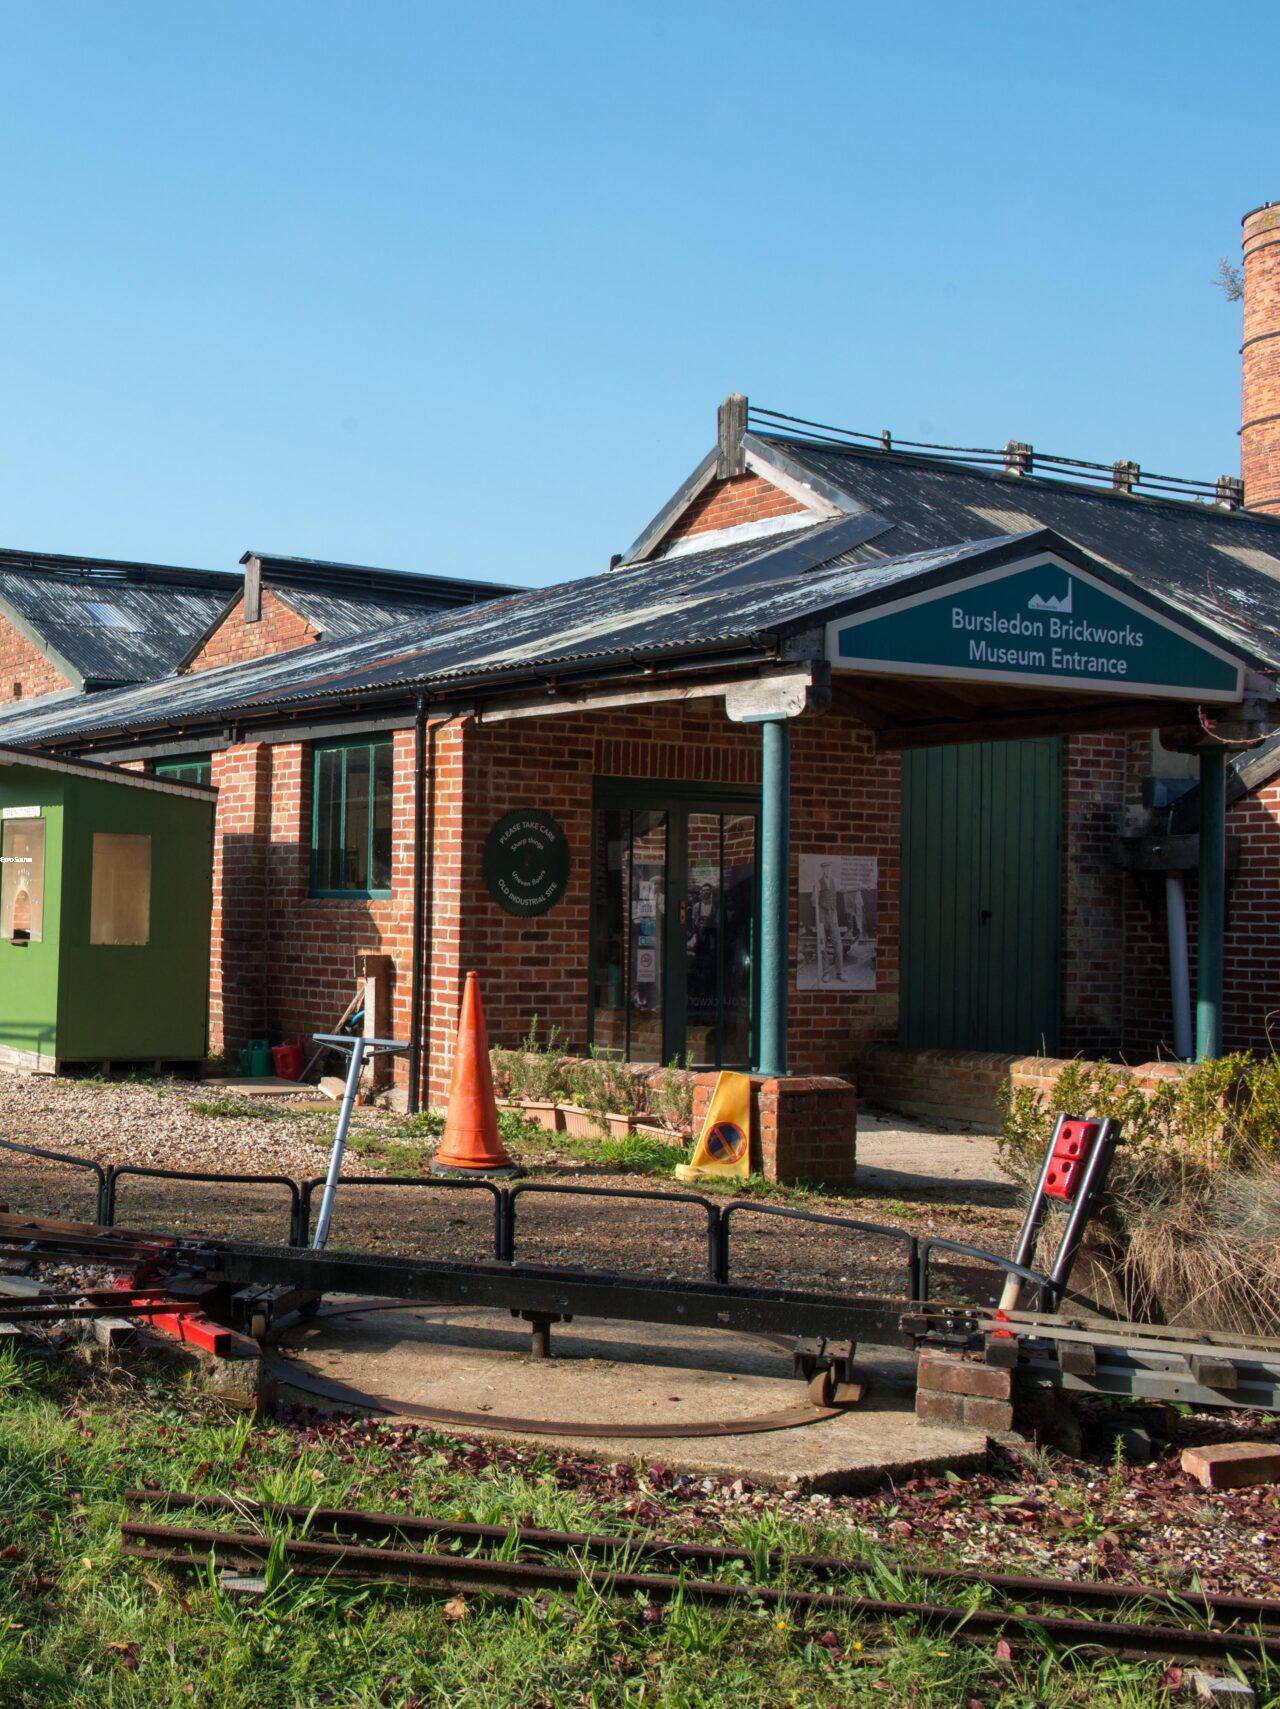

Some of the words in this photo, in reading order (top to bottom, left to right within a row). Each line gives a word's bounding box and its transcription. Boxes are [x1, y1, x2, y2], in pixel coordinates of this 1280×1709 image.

[952, 608, 1043, 637] Bursledon
[1050, 618, 1144, 647] Brickworks
[969, 639, 1045, 668] Museum
[1051, 648, 1127, 675] Entrance
[499, 823, 521, 845] PLEASE
[522, 821, 538, 830] TAKE
[539, 824, 556, 842] CARE
[498, 879, 509, 895] OLD
[508, 894, 546, 906] INDUSTRIAL
[545, 882, 558, 898] SITE
